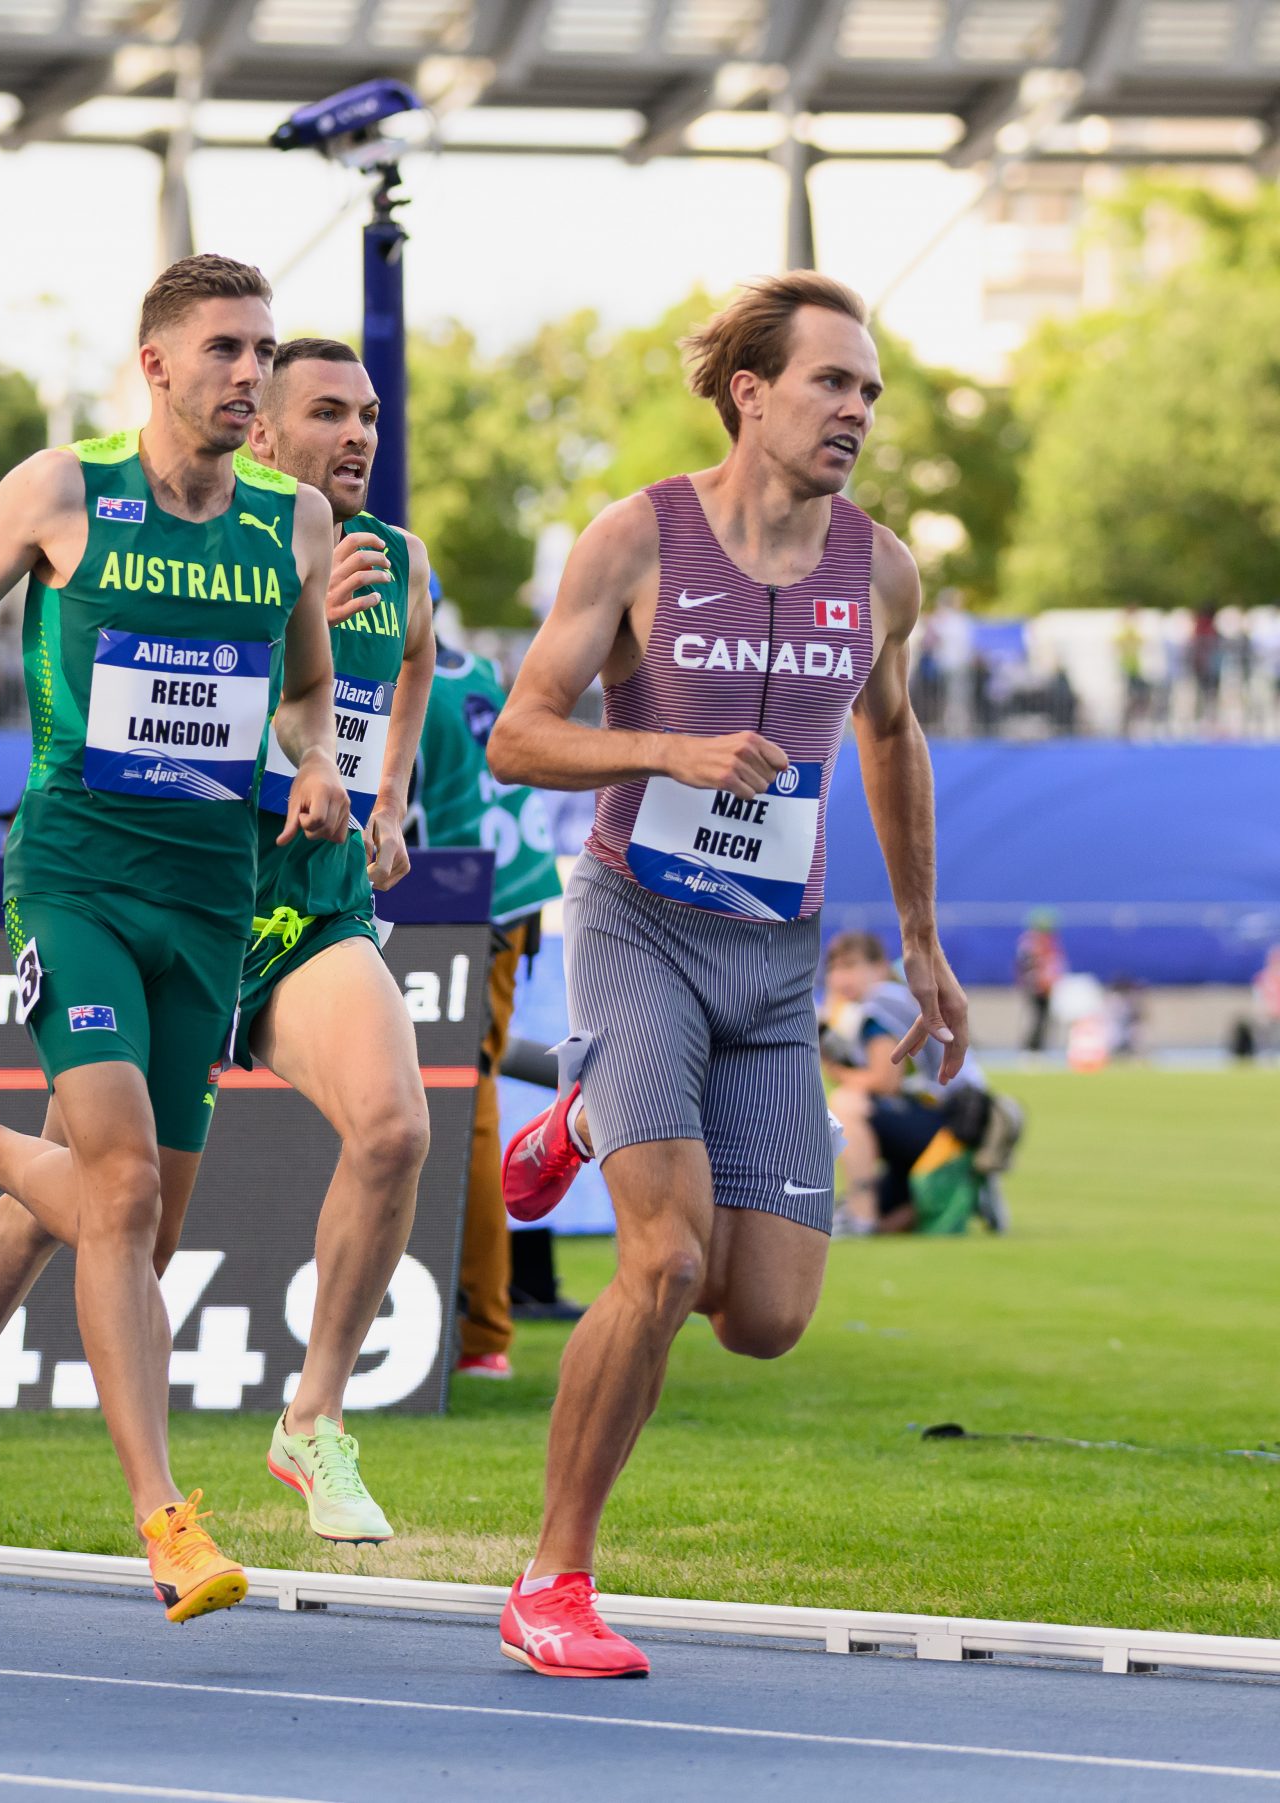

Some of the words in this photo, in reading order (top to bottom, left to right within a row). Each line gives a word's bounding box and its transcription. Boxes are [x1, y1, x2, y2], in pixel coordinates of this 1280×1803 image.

[99, 551, 281, 606] AUSTRALIA
[133, 641, 209, 667] Allianz
[673, 634, 853, 679] CANADA
[151, 679, 217, 708] REECE
[128, 717, 230, 747] LANGDON
[711, 789, 769, 825] NATE
[693, 826, 762, 863] RIECH
[20, 950, 38, 1007] 3
